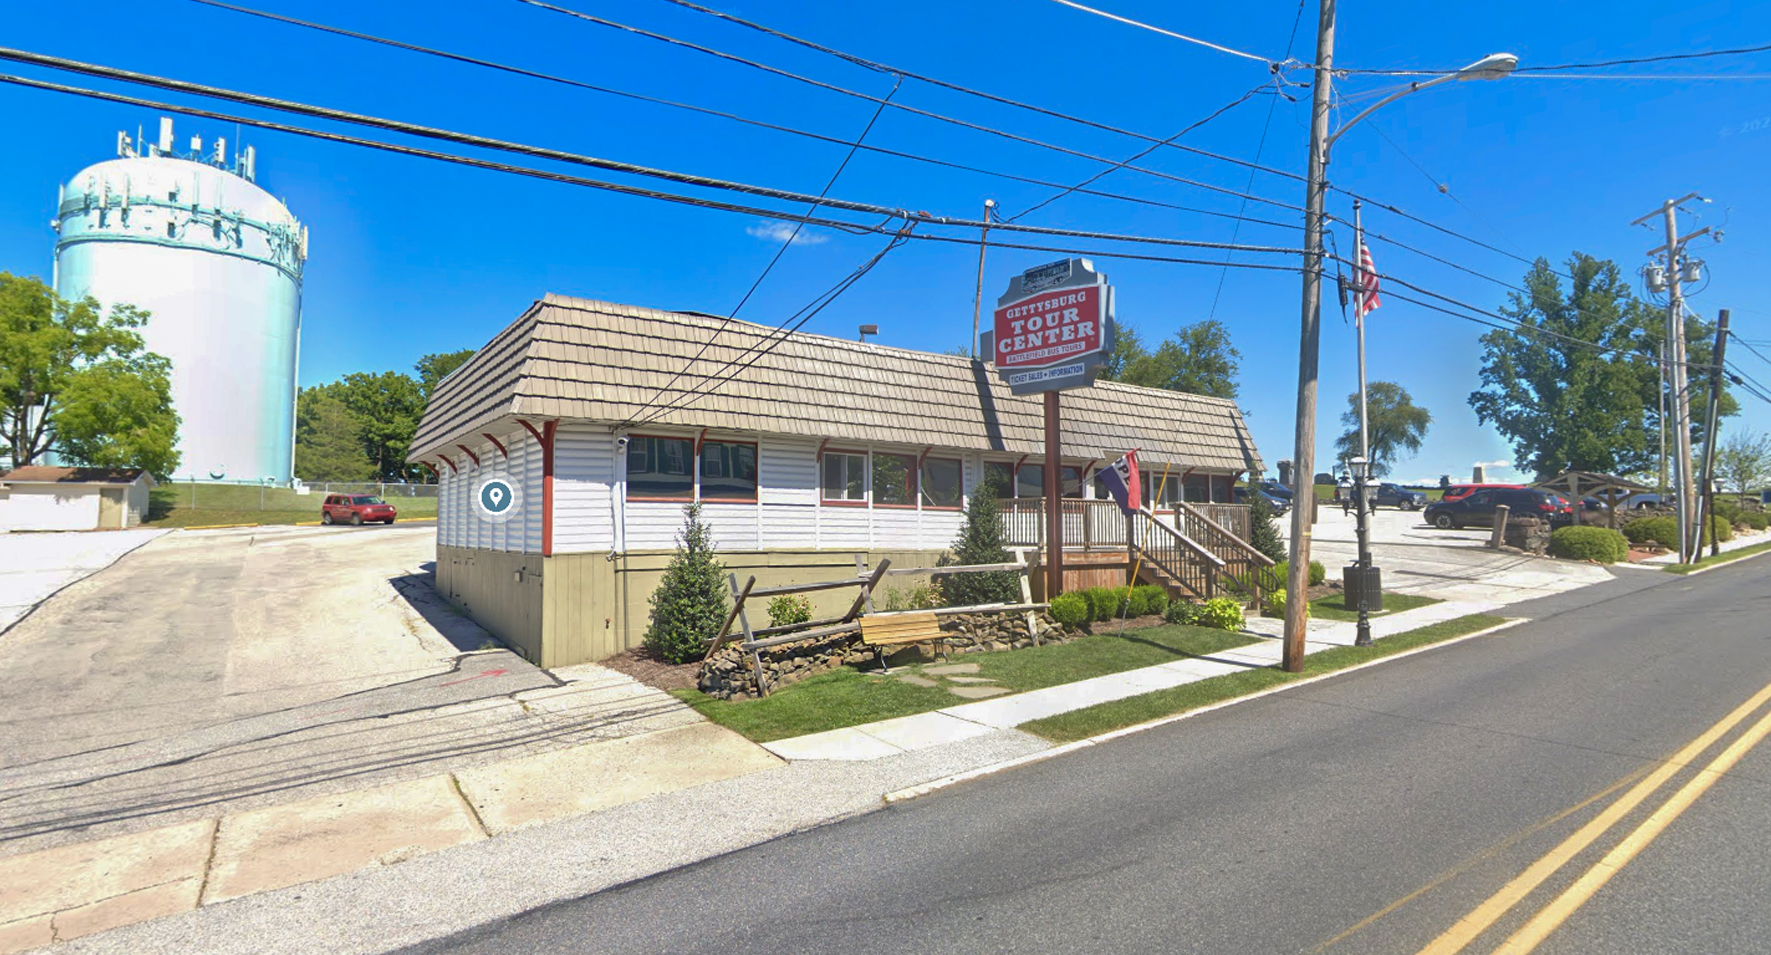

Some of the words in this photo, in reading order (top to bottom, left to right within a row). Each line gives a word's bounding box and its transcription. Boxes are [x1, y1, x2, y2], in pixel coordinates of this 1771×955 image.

[1006, 291, 1086, 319] GETTYSBURG
[1011, 307, 1080, 335] TOUR
[998, 321, 1095, 353] CENTER
[1009, 349, 1045, 362] BATTLEFIELD
[1047, 347, 1060, 356] BUS
[1061, 343, 1082, 352] TOURS
[1010, 374, 1028, 384] TICKET
[1028, 371, 1043, 381] SALES
[1048, 364, 1084, 378] INFORMATION
